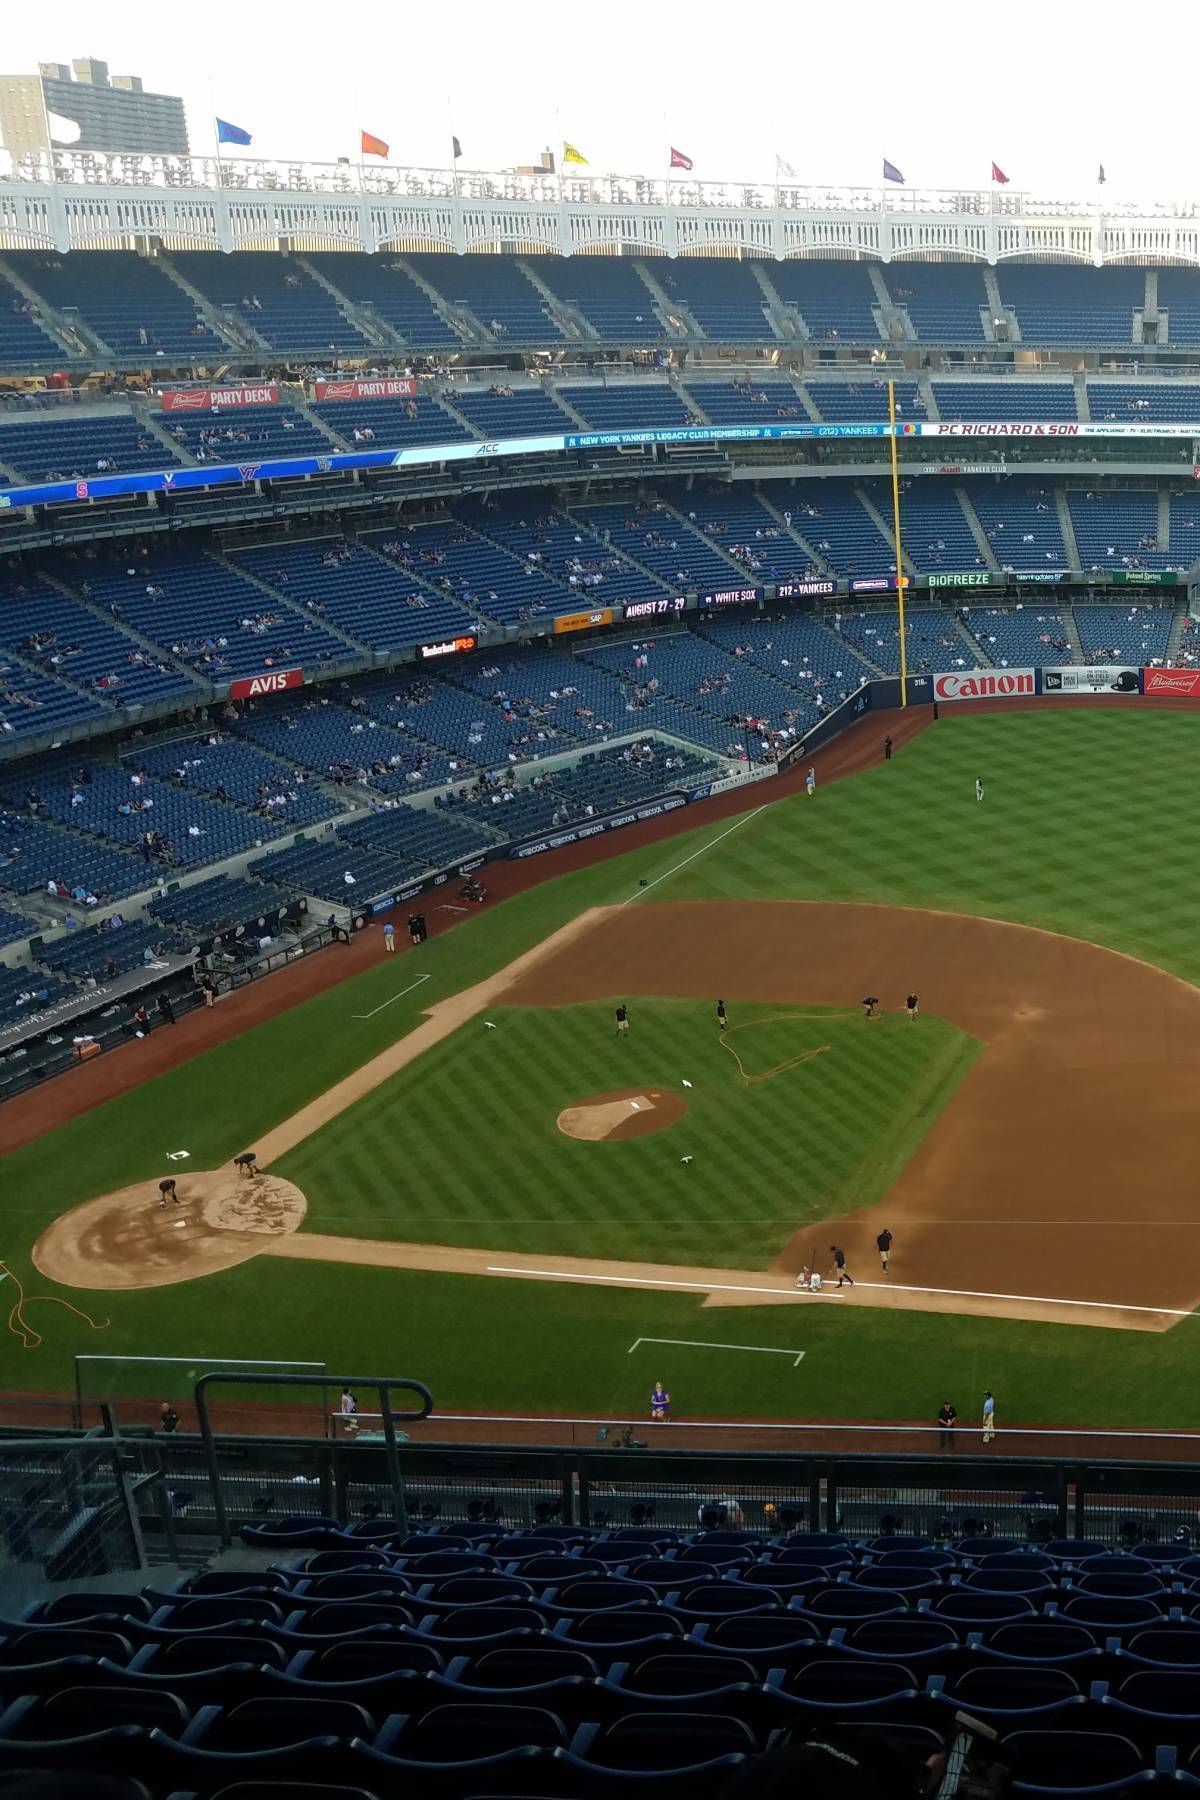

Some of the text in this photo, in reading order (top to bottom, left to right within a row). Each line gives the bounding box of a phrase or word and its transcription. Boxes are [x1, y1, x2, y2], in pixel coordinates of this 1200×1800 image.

[358, 381, 411, 395] PARTY DECK
[210, 389, 271, 404] PARTY DECK
[819, 427, 877, 436] (212) YANKEES
[962, 425, 1032, 434] RICHARD
[1035, 425, 1045, 434] &
[1048, 425, 1078, 434] SON
[580, 429, 760, 445] NEW YORK YANKEES LEGACY CLUB MEMBERSHIP
[715, 589, 755, 603] WHITE SOX
[779, 586, 792, 597] 212
[799, 582, 833, 595] YANKEES
[626, 602, 657, 618] AUGUST
[658, 600, 668, 612] 27
[675, 598, 685, 610] 29
[250, 674, 287, 695] AVIS
[935, 673, 1033, 698] Canon
[1152, 677, 1194, 687] Budweiser
[373, 897, 394, 911] GEICO
